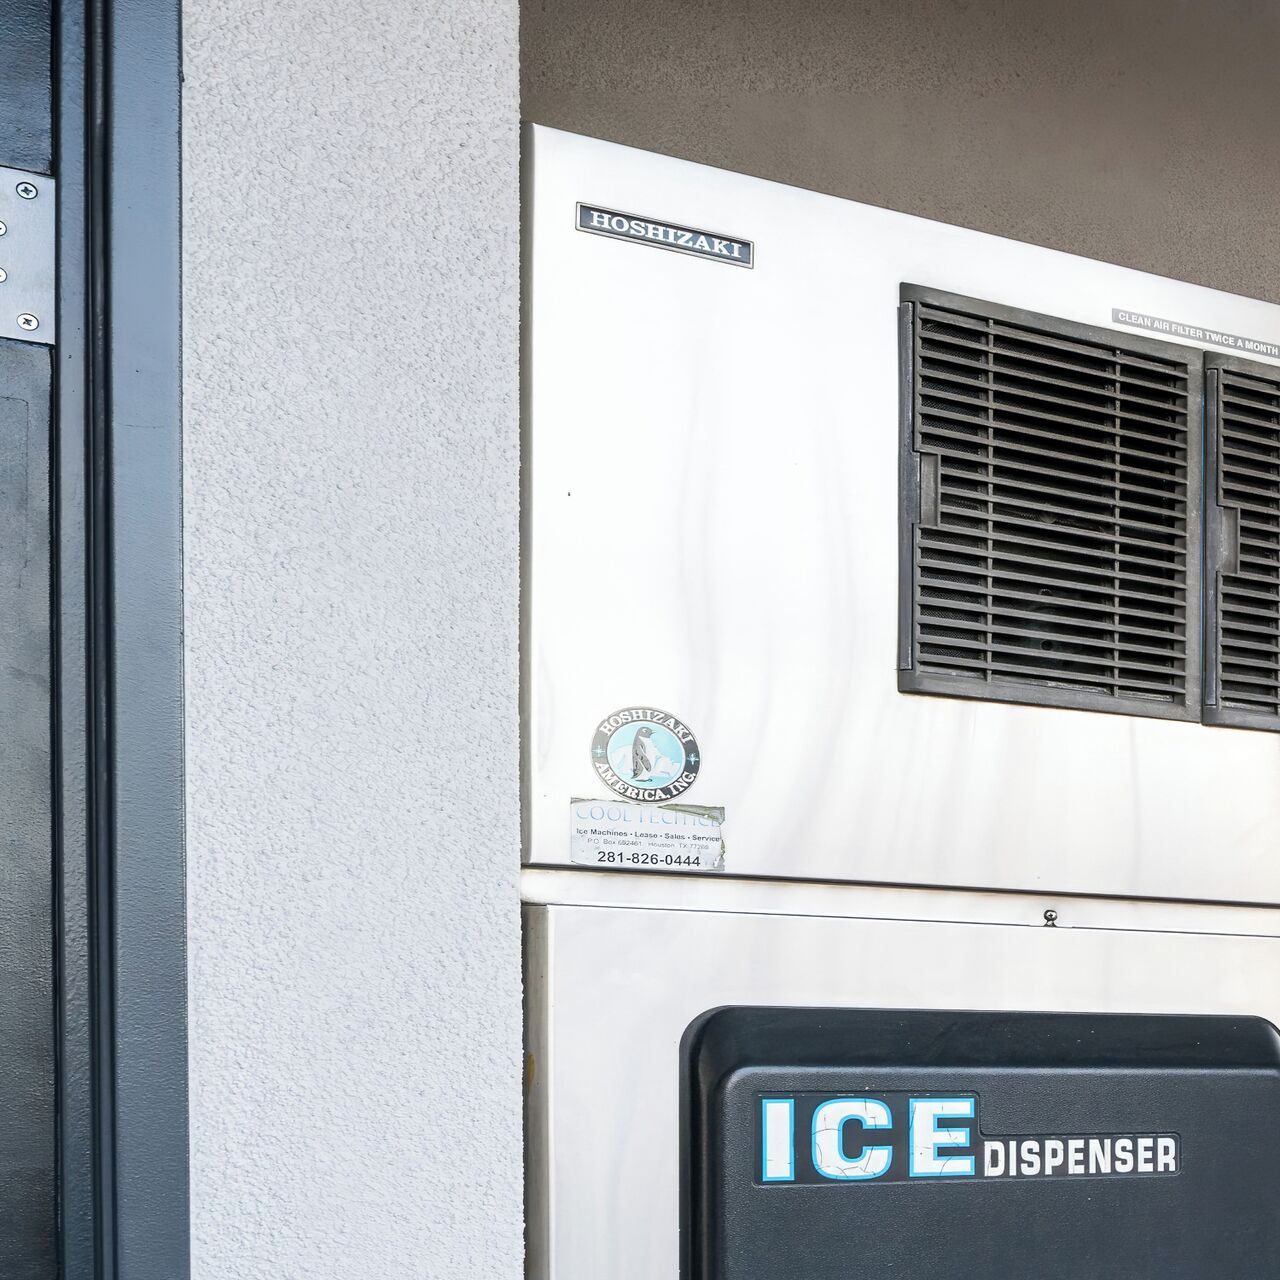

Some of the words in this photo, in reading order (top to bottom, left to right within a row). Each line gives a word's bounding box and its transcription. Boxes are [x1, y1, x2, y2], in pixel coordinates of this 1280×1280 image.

[590, 210, 742, 258] HOSHIZAKI
[1118, 312, 1151, 327] CLEAN
[1153, 319, 1170, 331] AIR
[1171, 323, 1203, 338] FILTER
[1204, 331, 1235, 346] TWICE
[1236, 338, 1244, 348] A
[1245, 341, 1279, 356] MONTH
[599, 709, 694, 744] HOSHIZAKI
[669, 772, 697, 796] INC.
[576, 806, 632, 823] COOL
[590, 828, 628, 837] Machines
[634, 831, 658, 839] Lease
[692, 834, 720, 843] Service
[597, 851, 701, 867] 281-826-0444
[761, 1097, 976, 1182] ICE
[984, 1136, 1177, 1177] DISPENSER
